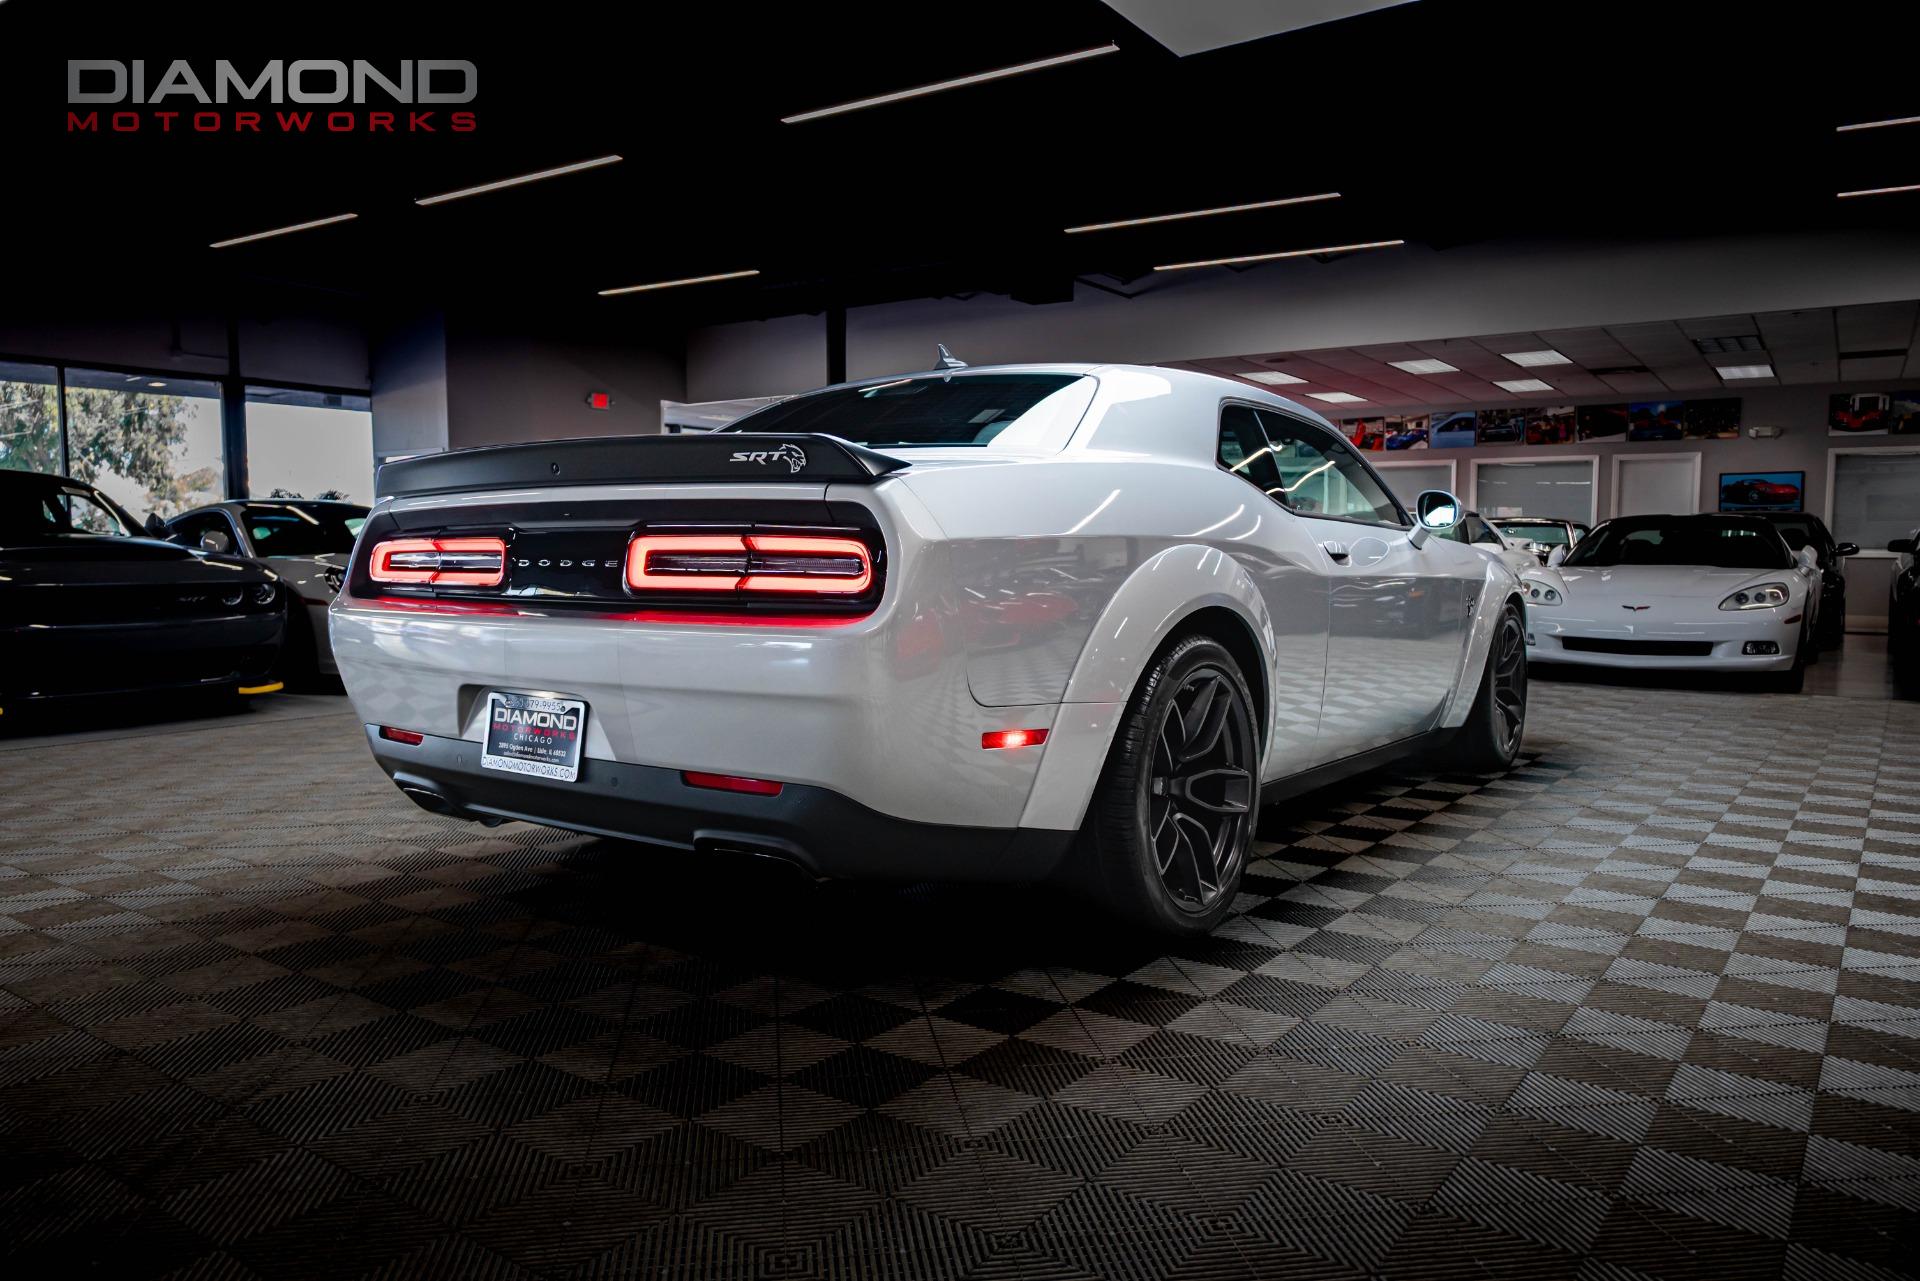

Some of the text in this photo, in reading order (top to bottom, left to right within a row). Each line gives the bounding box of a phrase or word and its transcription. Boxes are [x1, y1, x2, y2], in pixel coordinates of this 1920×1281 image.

[729, 451, 787, 465] SRT
[518, 559, 618, 567] DODGE
[494, 708, 577, 731] DIAMOND
[492, 723, 575, 741] MOTORWORKS
[513, 734, 552, 745] CHICAGO
[482, 757, 576, 779] DIAMONDMOTORWORKS.COM
